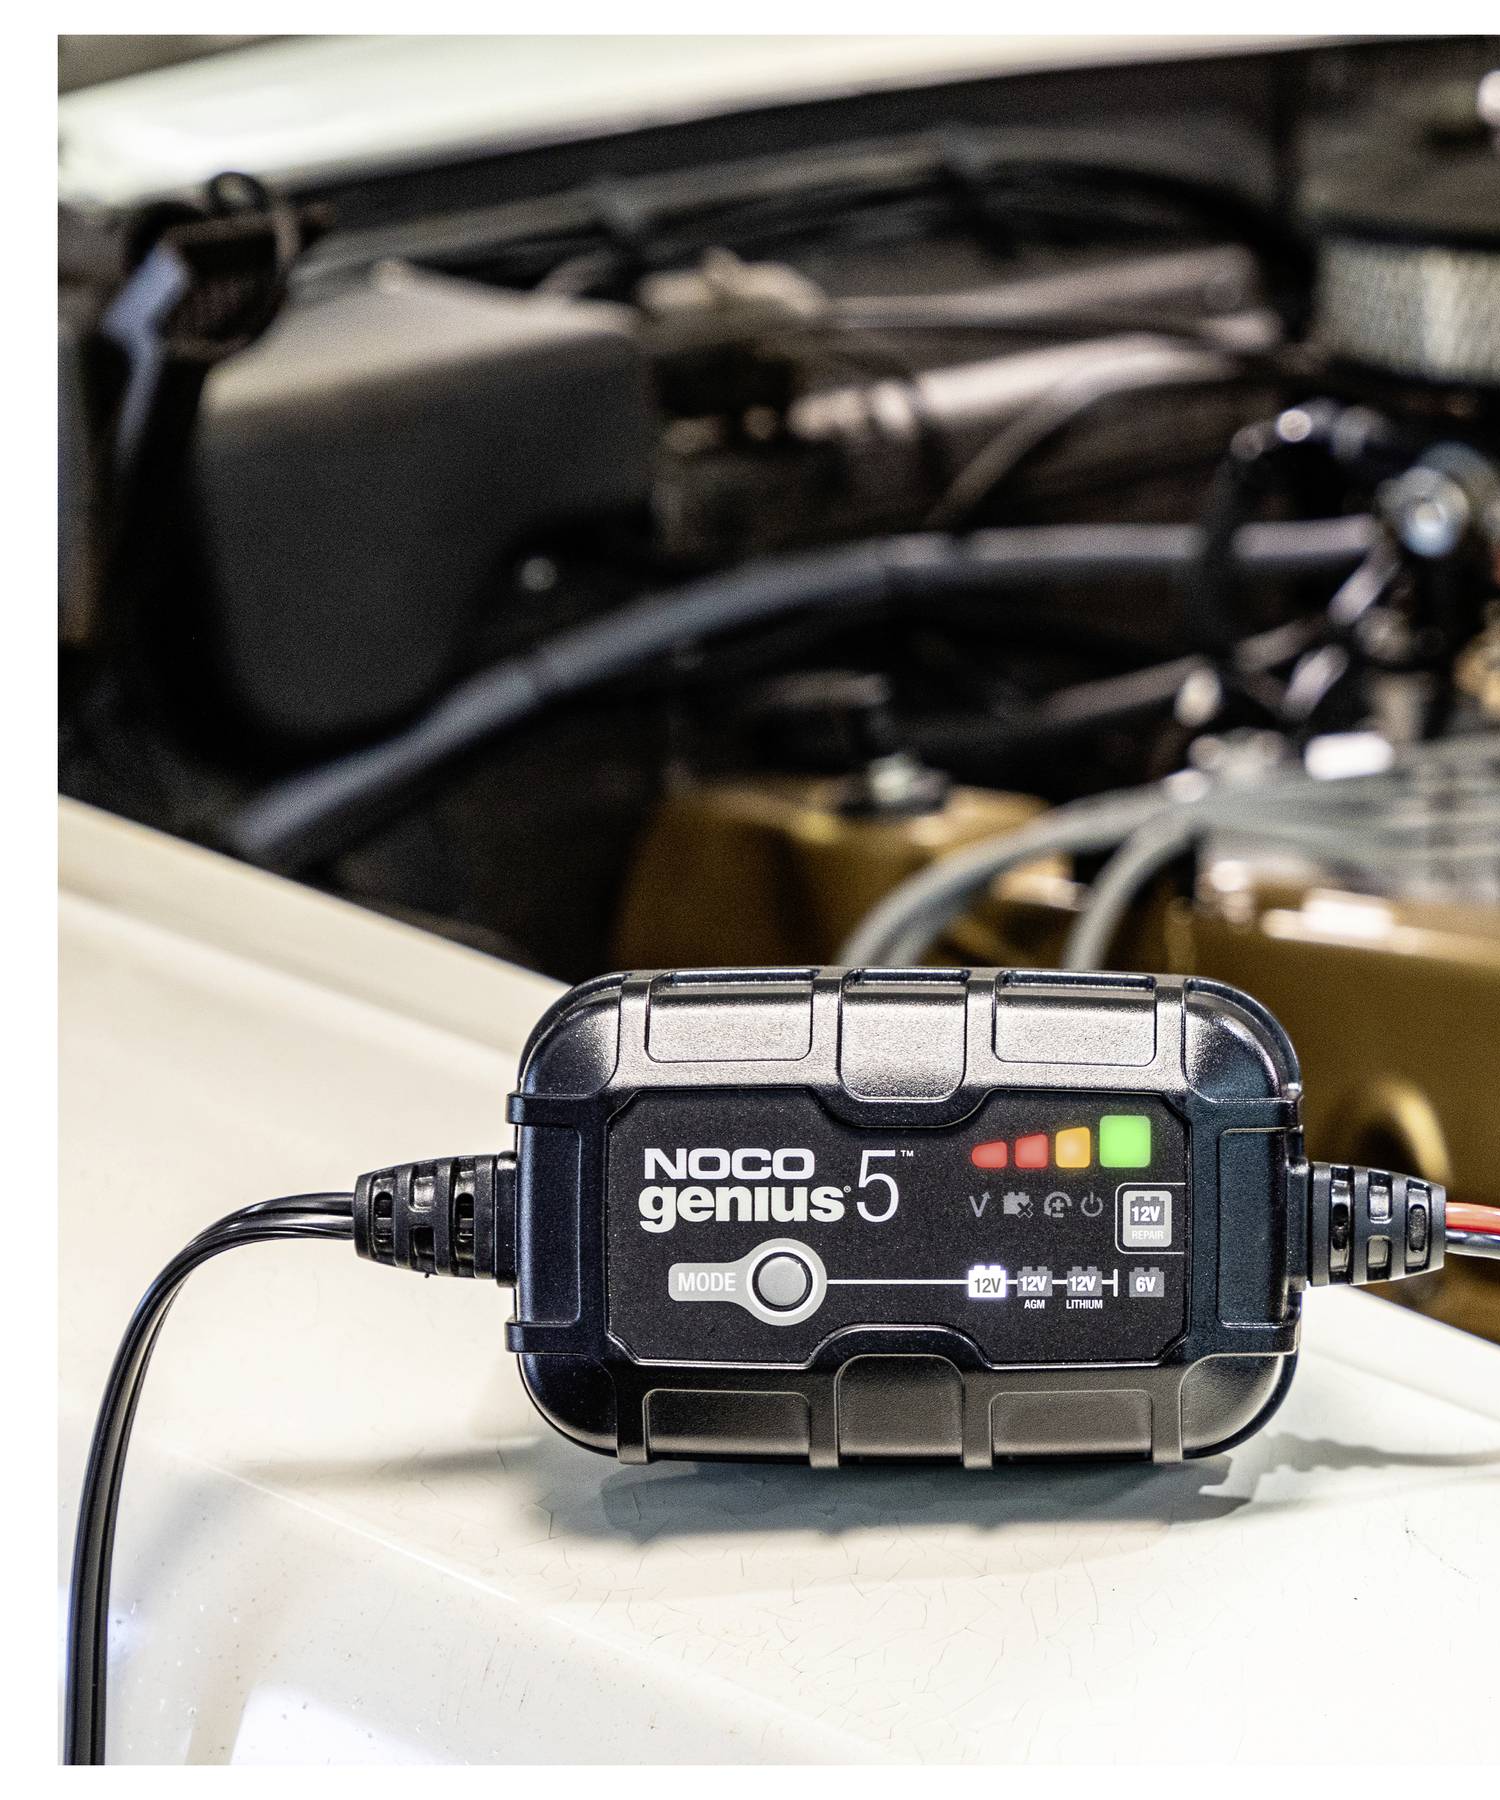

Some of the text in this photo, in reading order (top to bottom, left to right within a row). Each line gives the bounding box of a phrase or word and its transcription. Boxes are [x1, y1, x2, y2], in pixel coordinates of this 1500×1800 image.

[644, 1147, 815, 1180] NOCO
[1131, 1205, 1160, 1222] 12V
[1131, 1230, 1164, 1240] REPAIR
[677, 1272, 736, 1292] MODE
[974, 1275, 1156, 1293] 12V 12V 12V 6V
[1023, 1299, 1103, 1309] AGM LITHIUM
